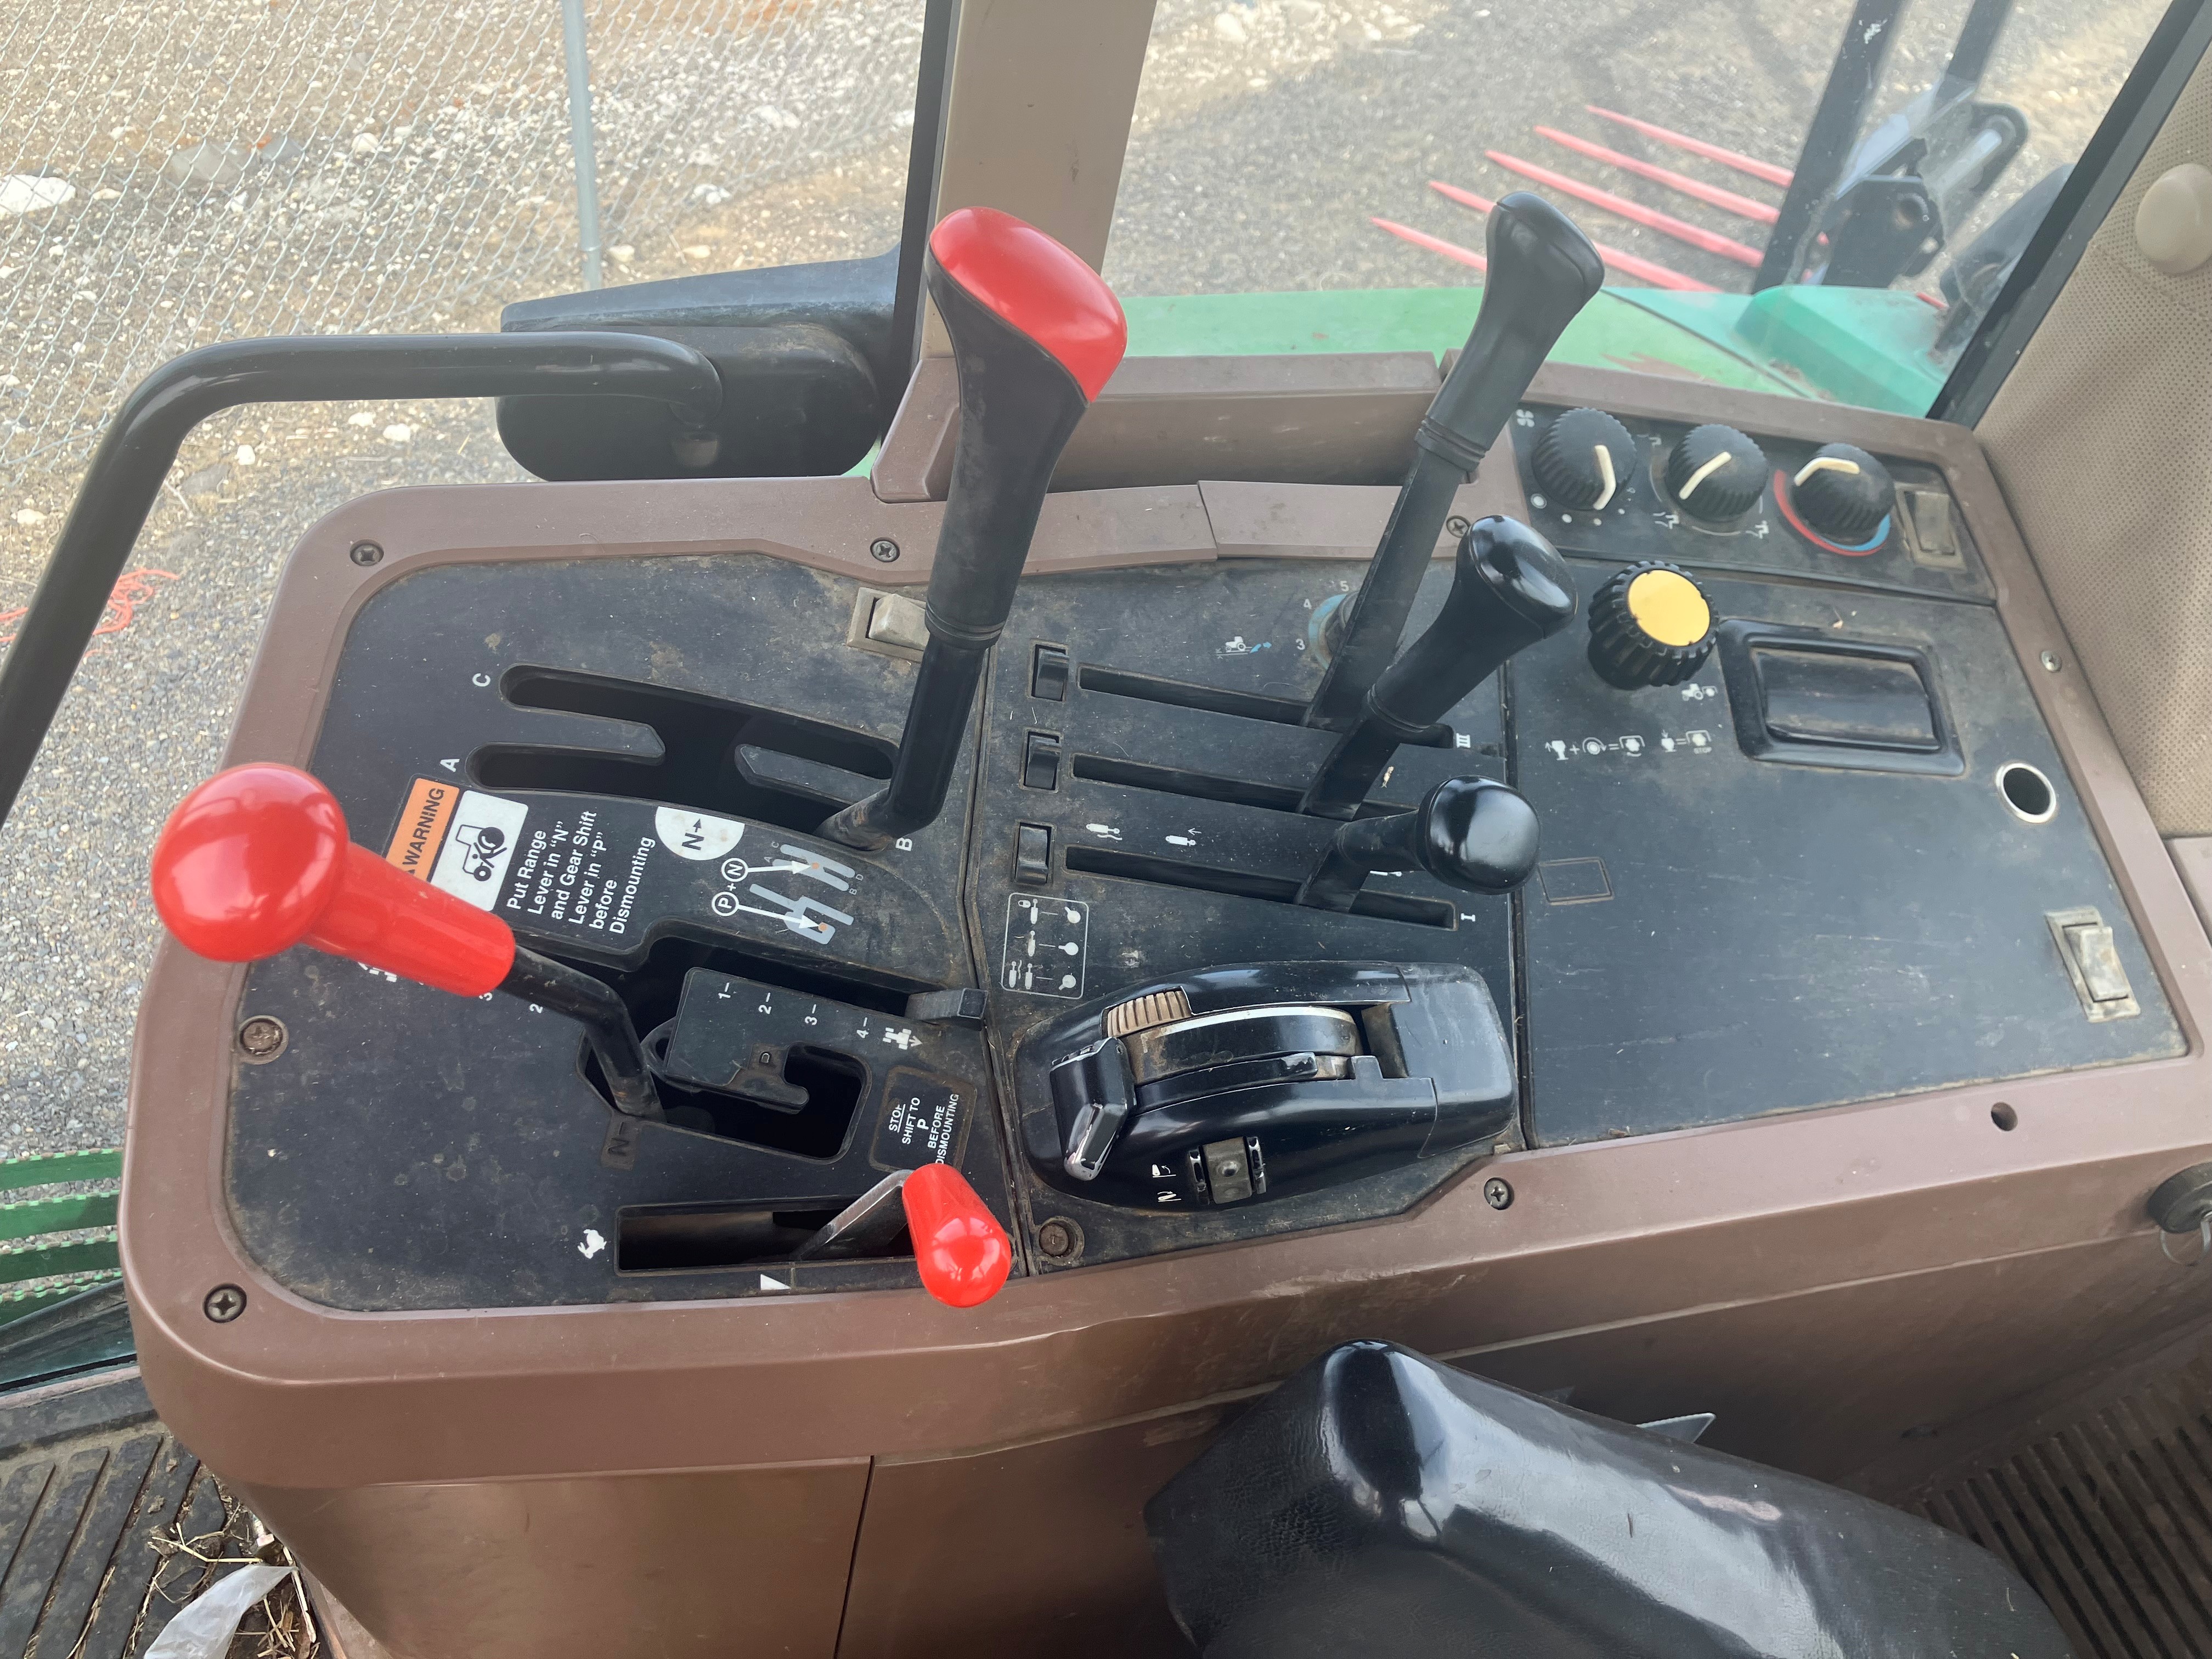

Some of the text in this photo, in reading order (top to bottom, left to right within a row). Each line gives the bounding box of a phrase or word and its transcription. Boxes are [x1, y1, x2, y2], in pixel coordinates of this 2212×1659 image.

[1340, 580, 1349, 592] 5
[1304, 599, 1312, 610] 4
[1296, 639, 1305, 650] 3
[472, 673, 490, 687] C
[440, 758, 460, 772] A
[402, 788, 445, 865] WARNING
[681, 832, 705, 851] N
[895, 837, 913, 851] B
[506, 831, 546, 909] Put Range
[551, 811, 596, 919] and Gear Shift
[727, 863, 743, 876] N
[528, 871, 554, 914] Lever
[544, 853, 561, 867] in
[610, 837, 655, 933] Dismounting
[568, 881, 594, 924] Lever
[584, 864, 601, 877] in
[589, 880, 617, 929] before
[718, 897, 732, 909] P
[529, 1003, 543, 1014] 2
[758, 1005, 772, 1014] 2
[805, 1016, 817, 1026] 3
[856, 1029, 869, 1039] 4
[902, 1098, 920, 1144] SHIFT TO
[917, 1119, 929, 1130] P
[928, 1105, 945, 1148] BEFORE
[935, 1094, 958, 1164] DISMOUNTING
[607, 1137, 629, 1156] N
